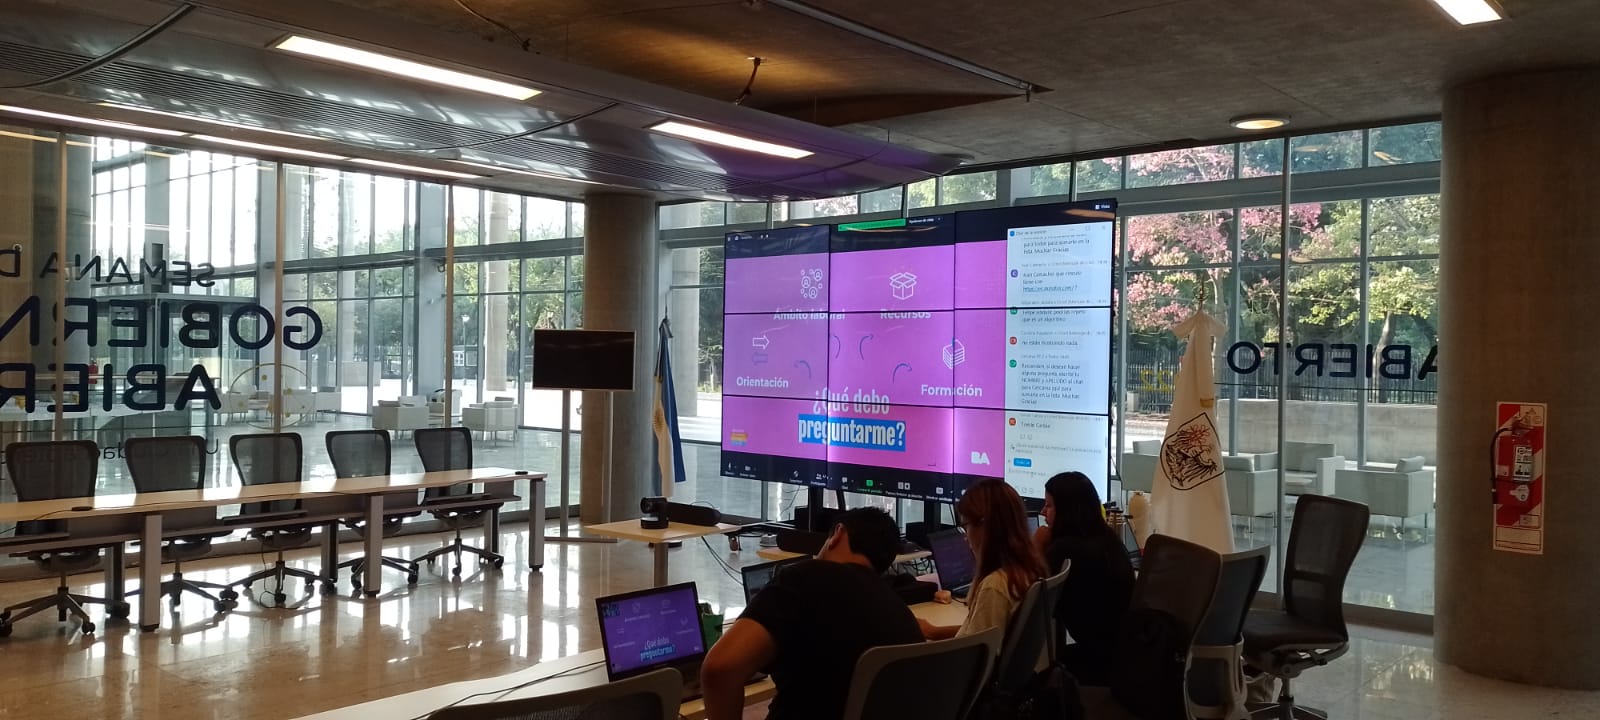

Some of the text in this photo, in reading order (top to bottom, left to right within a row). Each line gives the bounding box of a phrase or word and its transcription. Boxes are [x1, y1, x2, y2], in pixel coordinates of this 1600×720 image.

[880, 308, 932, 319] Recursos
[736, 376, 789, 389] Orientación
[921, 384, 982, 397] Formación
[812, 386, 890, 414] ¿Qué debo
[798, 419, 906, 446] preguntarme?
[971, 452, 990, 465] BA
